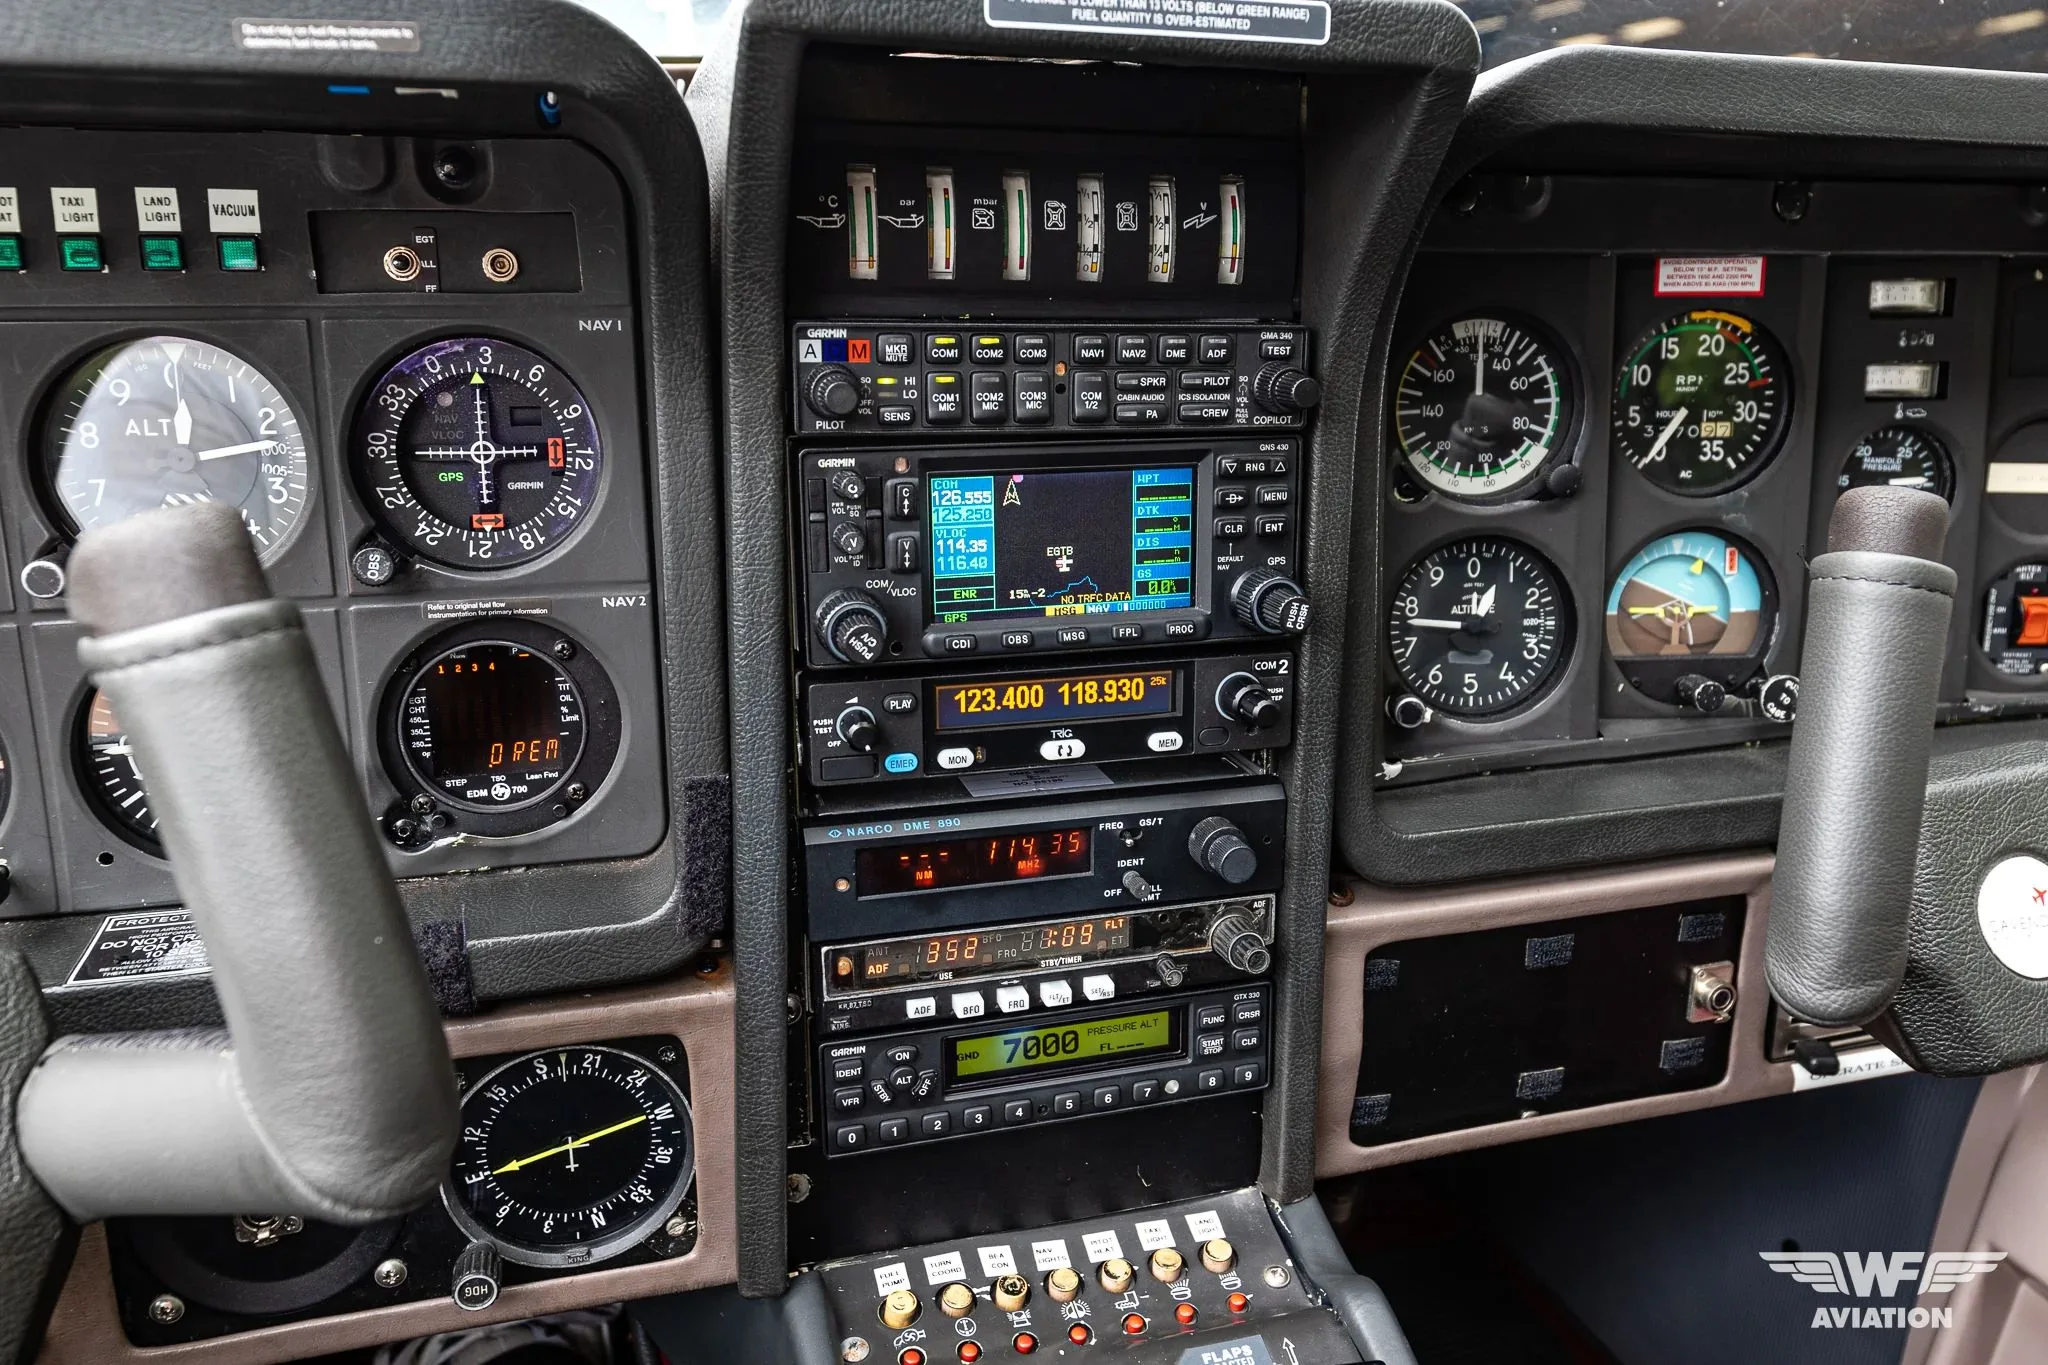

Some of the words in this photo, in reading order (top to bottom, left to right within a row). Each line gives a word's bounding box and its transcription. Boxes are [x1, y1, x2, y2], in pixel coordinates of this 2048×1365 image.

[1162, 0, 1194, 12] VOLTS
[1236, 4, 1271, 17] GREEN
[1272, 6, 1310, 23] RANGE)
[1072, 8, 1099, 22] FUEL
[1100, 10, 1152, 24] QUANTITY
[1153, 13, 1164, 26] IS
[1164, 14, 1251, 30] OVER-ESTIMATED
[60, 196, 85, 206] TAXI
[143, 196, 172, 206] LAND
[212, 204, 256, 218] VACUUM
[62, 212, 94, 222] LIGHT
[144, 212, 177, 222] LIGHT
[416, 235, 434, 244] EGT
[807, 328, 848, 339] GARMIN
[885, 344, 908, 354] MKR
[1660, 337, 1680, 360] 15
[1697, 334, 1724, 356] 20
[932, 348, 958, 358] COM1
[976, 349, 1004, 358] COM2
[1020, 349, 1047, 358] COM3
[1081, 349, 1105, 358] NAV1
[1122, 349, 1146, 358] NAV2
[1166, 349, 1186, 358] DME
[1207, 349, 1226, 358] ADF
[1267, 346, 1291, 356] TEST
[886, 354, 908, 362] MUTE
[1492, 358, 1512, 371] 40
[1432, 368, 1455, 382] 160
[1632, 364, 1651, 386] 10
[1724, 362, 1750, 386] 25
[904, 377, 916, 386] HI
[1140, 377, 1166, 387] SPKR
[1204, 376, 1230, 386] PILOT
[1510, 376, 1528, 390] 60
[902, 390, 918, 400] LO
[932, 393, 960, 402] COM1
[976, 392, 1004, 402] COM2
[1020, 391, 1047, 400] COM3
[1080, 392, 1102, 401] COM
[1116, 394, 1140, 402] CABIN
[1140, 394, 1165, 402] AUDIO
[938, 402, 956, 412] MIC
[982, 401, 999, 410] MIC
[1026, 400, 1042, 410] MIC
[1084, 400, 1098, 410] 1/2
[1146, 410, 1158, 419] PA
[1202, 408, 1229, 418] CREW
[1422, 404, 1444, 417] 140
[1732, 400, 1758, 422] 30
[884, 412, 910, 422] SENS
[1253, 415, 1292, 426] COPILOT
[125, 418, 171, 436] ALT
[815, 420, 846, 430] PILOT
[1512, 416, 1530, 430] 80
[1436, 440, 1451, 450] 120
[1699, 440, 1724, 462] 35
[1478, 452, 1493, 462] 100
[1864, 456, 1902, 464] MANIFOLD
[818, 458, 856, 468] GARMIN
[1245, 462, 1266, 472] RNG
[1862, 463, 1902, 472] PRESSURE
[438, 472, 464, 482] GPS
[1138, 474, 1160, 484] WPT
[1680, 470, 1692, 478] AC
[508, 480, 544, 490] GARMIN
[934, 480, 958, 490] COM
[932, 490, 992, 506] 126.555
[1264, 491, 1288, 502] MENU
[932, 508, 992, 523] 125.250
[1137, 506, 1160, 516] DTK
[1224, 524, 1243, 534] CLR
[1266, 522, 1284, 532] ENT
[935, 528, 966, 538] VLOC
[936, 538, 988, 555] 114.35
[1137, 538, 1160, 547] DIS
[1046, 546, 1074, 556] EGTB
[937, 554, 988, 571] 116.40
[1268, 556, 1286, 566] GPS
[366, 554, 380, 580] OBS
[953, 589, 977, 600] ENR
[1060, 594, 1075, 604] NO
[1078, 593, 1103, 604] TRFC
[1106, 591, 1132, 602] DATA
[454, 602, 478, 610] original
[602, 596, 634, 608] NAV
[639, 596, 647, 606] 2
[428, 610, 476, 619] instrumentation
[944, 613, 968, 623] GPS
[1286, 602, 1300, 628] PUSH
[1296, 604, 1310, 630] CRSR
[1118, 627, 1138, 638] FPL
[1169, 624, 1194, 634] PROC
[1008, 634, 1028, 644] OBS
[1062, 631, 1086, 642] MSG
[952, 640, 971, 648] CDI
[1254, 661, 1277, 671] COM
[1278, 659, 1289, 674] 2
[954, 684, 1044, 714] 123.400
[1058, 676, 1145, 706] 118.930
[890, 698, 913, 710] PLAY
[1158, 738, 1177, 748] MEM
[890, 758, 914, 769] EMER
[948, 755, 968, 765] MON
[444, 778, 468, 788] STEP
[466, 789, 488, 798] EDM
[511, 785, 528, 794] 700
[846, 824, 893, 837] NARCO
[904, 820, 930, 832] DME
[938, 817, 961, 828] 890
[1099, 822, 1124, 831] FREQ
[1139, 818, 1164, 827] GS/T
[1117, 858, 1145, 868] IDENT
[916, 870, 933, 880] NM
[1104, 888, 1122, 898] OFF
[116, 914, 190, 927] PROTECT
[1105, 918, 1124, 930] FLT
[100, 940, 128, 950] DO
[130, 936, 170, 947] NOT
[1040, 956, 1082, 968] STBY/TIMER
[868, 962, 890, 975] ADF
[1202, 1014, 1225, 1024] FUNC
[1238, 1010, 1260, 1020] CRSR
[1087, 1021, 1136, 1036] PRESSURE
[1140, 1018, 1160, 1029] ALT
[1003, 1030, 1079, 1064] 7000
[1202, 1038, 1224, 1048] START
[1241, 1038, 1257, 1046] CLR
[830, 1046, 866, 1057] GARMIN
[1203, 1046, 1222, 1055] STOP
[895, 1052, 910, 1061] ON
[957, 1051, 980, 1062] GND
[836, 1068, 862, 1078] IDENT
[896, 1075, 913, 1084] ALT
[918, 1078, 932, 1096] OFF
[873, 1084, 892, 1104] STBY
[842, 1098, 860, 1106] VFR
[991, 1262, 1009, 1270] CON
[464, 1284, 488, 1297] HDG
[1200, 1344, 1253, 1364] FLAPS
